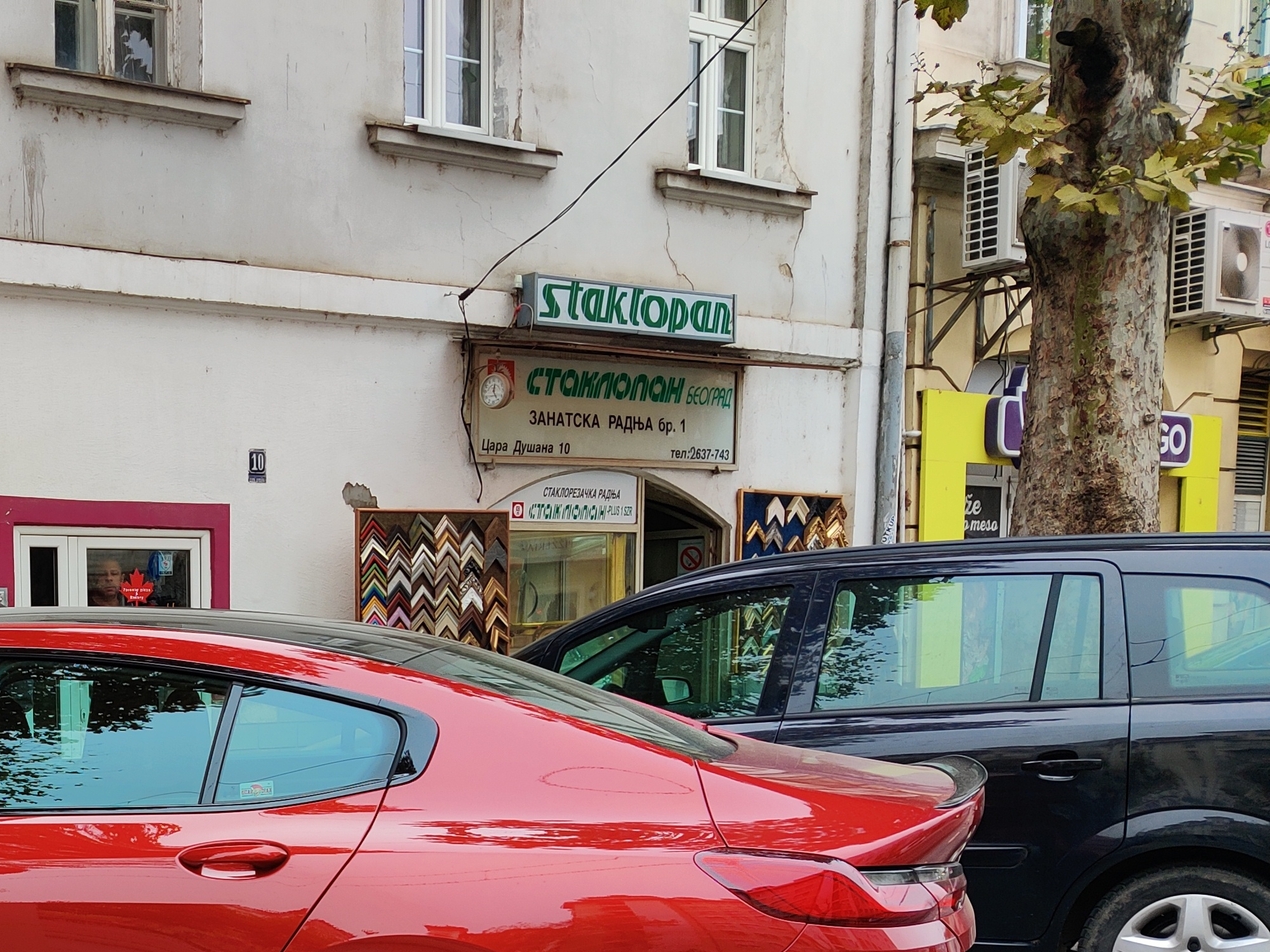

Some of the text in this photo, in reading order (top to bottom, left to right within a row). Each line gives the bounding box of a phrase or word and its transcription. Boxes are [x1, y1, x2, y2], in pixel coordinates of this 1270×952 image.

[538, 280, 732, 335] staklopan
[686, 386, 733, 409] БЕОГРАД
[529, 409, 686, 435] ЗАНАТСКА РАДЊА бр. 1
[481, 438, 571, 455] Цара Душана 10
[251, 453, 264, 471] 10
[543, 487, 621, 500] СТАКЛОРЕЗАЧКА РАДЊА
[970, 519, 998, 532] meso
